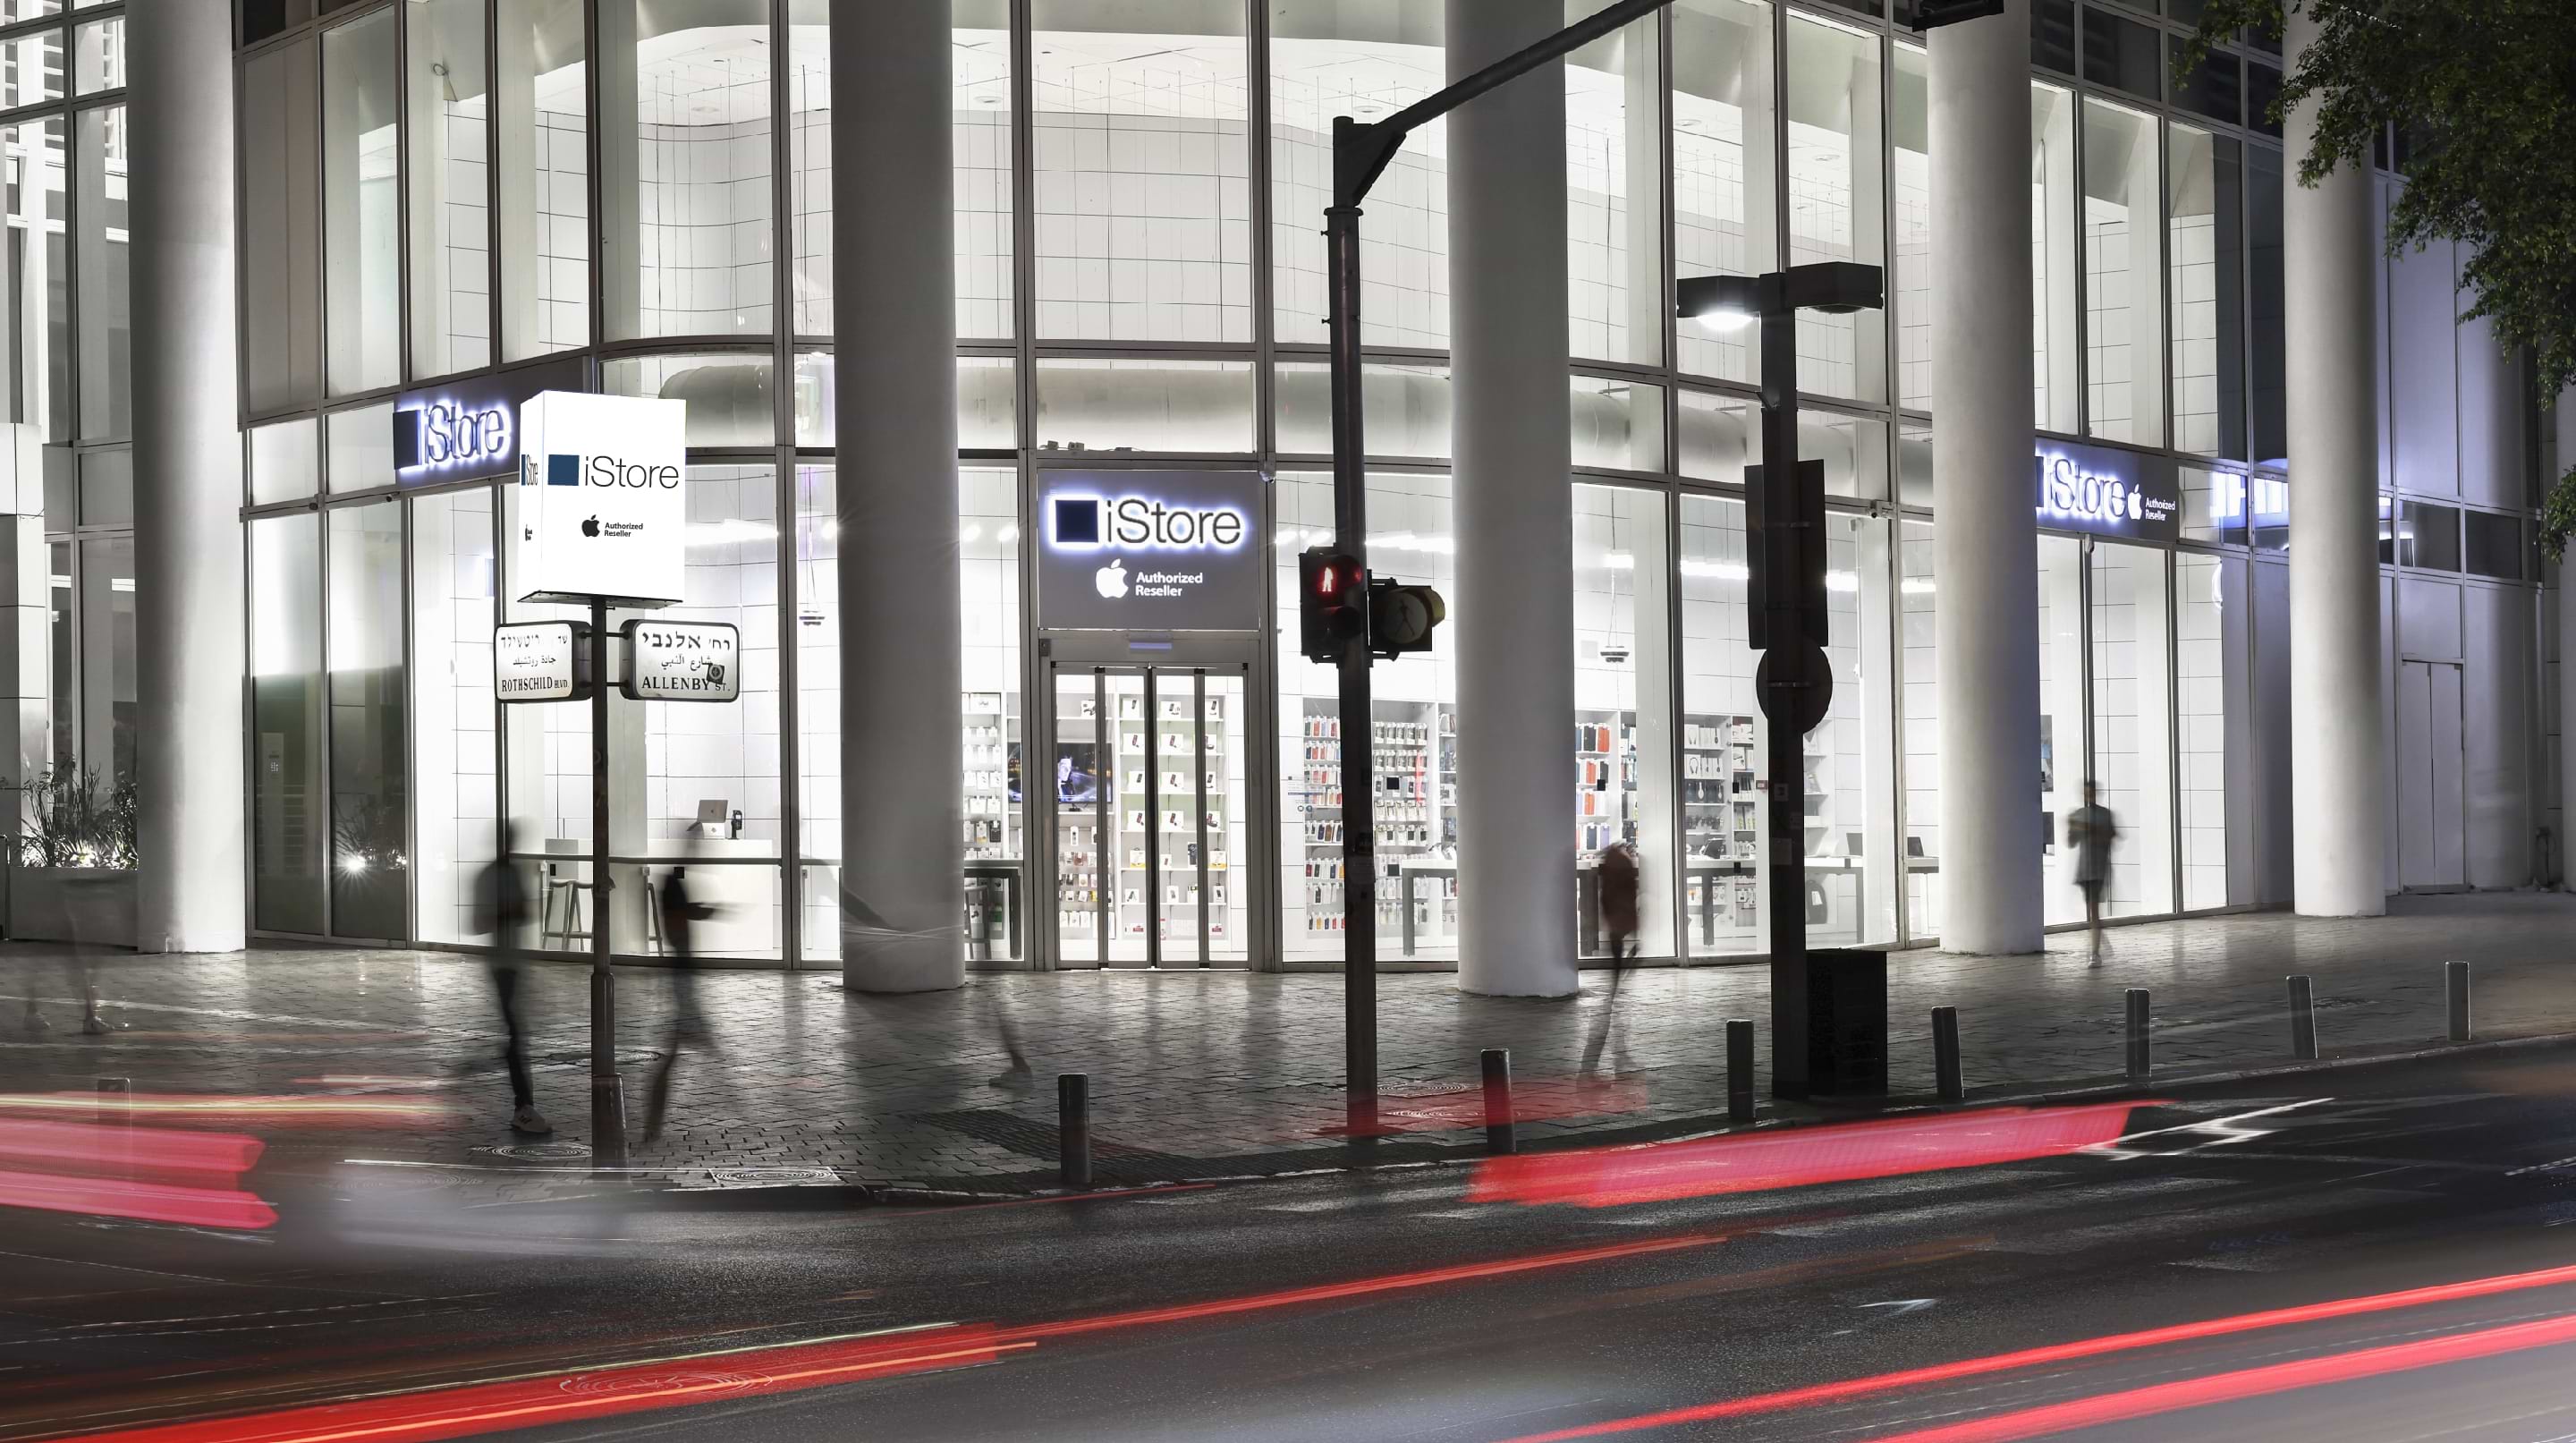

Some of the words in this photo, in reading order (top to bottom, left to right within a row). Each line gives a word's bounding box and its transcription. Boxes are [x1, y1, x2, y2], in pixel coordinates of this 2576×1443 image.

[424, 404, 504, 464] iStore
[526, 454, 538, 486] Store
[585, 455, 679, 488] iStore
[2046, 458, 2126, 517] iStore
[2146, 497, 2175, 511] Authorized
[1107, 498, 1241, 545] iStore
[2145, 509, 2166, 522] Reseller
[604, 530, 631, 538] Reseller
[605, 522, 644, 531] Authorized
[1136, 571, 1203, 583] Authorized
[1135, 584, 1182, 597] Reseller
[642, 631, 700, 649] אלנבי
[708, 638, 730, 650] רח'
[502, 676, 553, 692] ROTHSCHILD
[641, 675, 709, 691] ALLENBY
[715, 683, 731, 692] ST.
